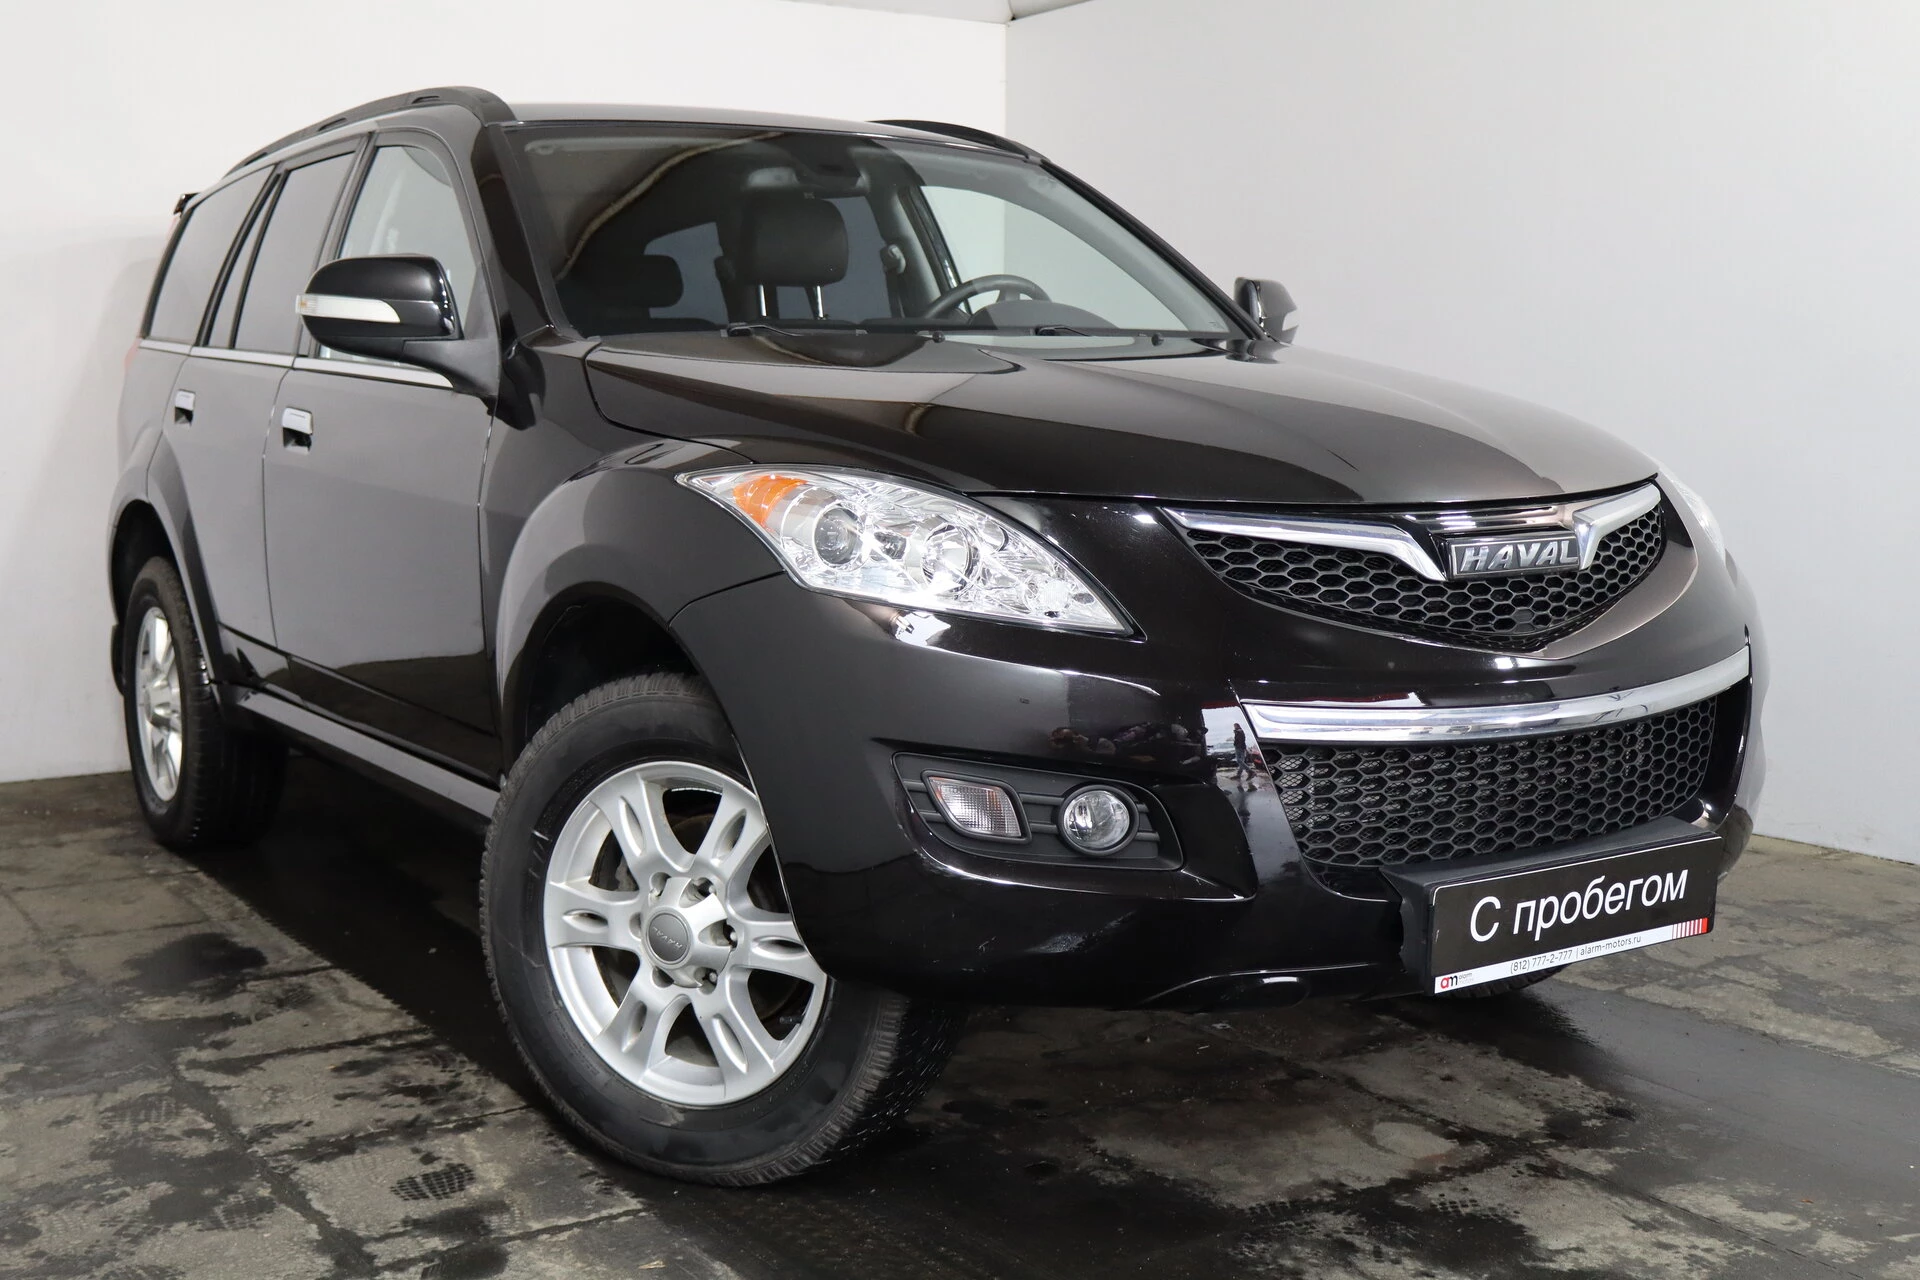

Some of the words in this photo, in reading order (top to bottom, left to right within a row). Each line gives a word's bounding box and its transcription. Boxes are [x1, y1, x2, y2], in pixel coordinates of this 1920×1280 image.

[1460, 540, 1579, 571] HAVAL
[1470, 896, 1501, 942] С
[1513, 869, 1689, 941] пробегом
[1510, 959, 1531, 974] (812)
[1532, 950, 1573, 967] 777-2-777
[1580, 936, 1642, 956] alarm-motors.ru
